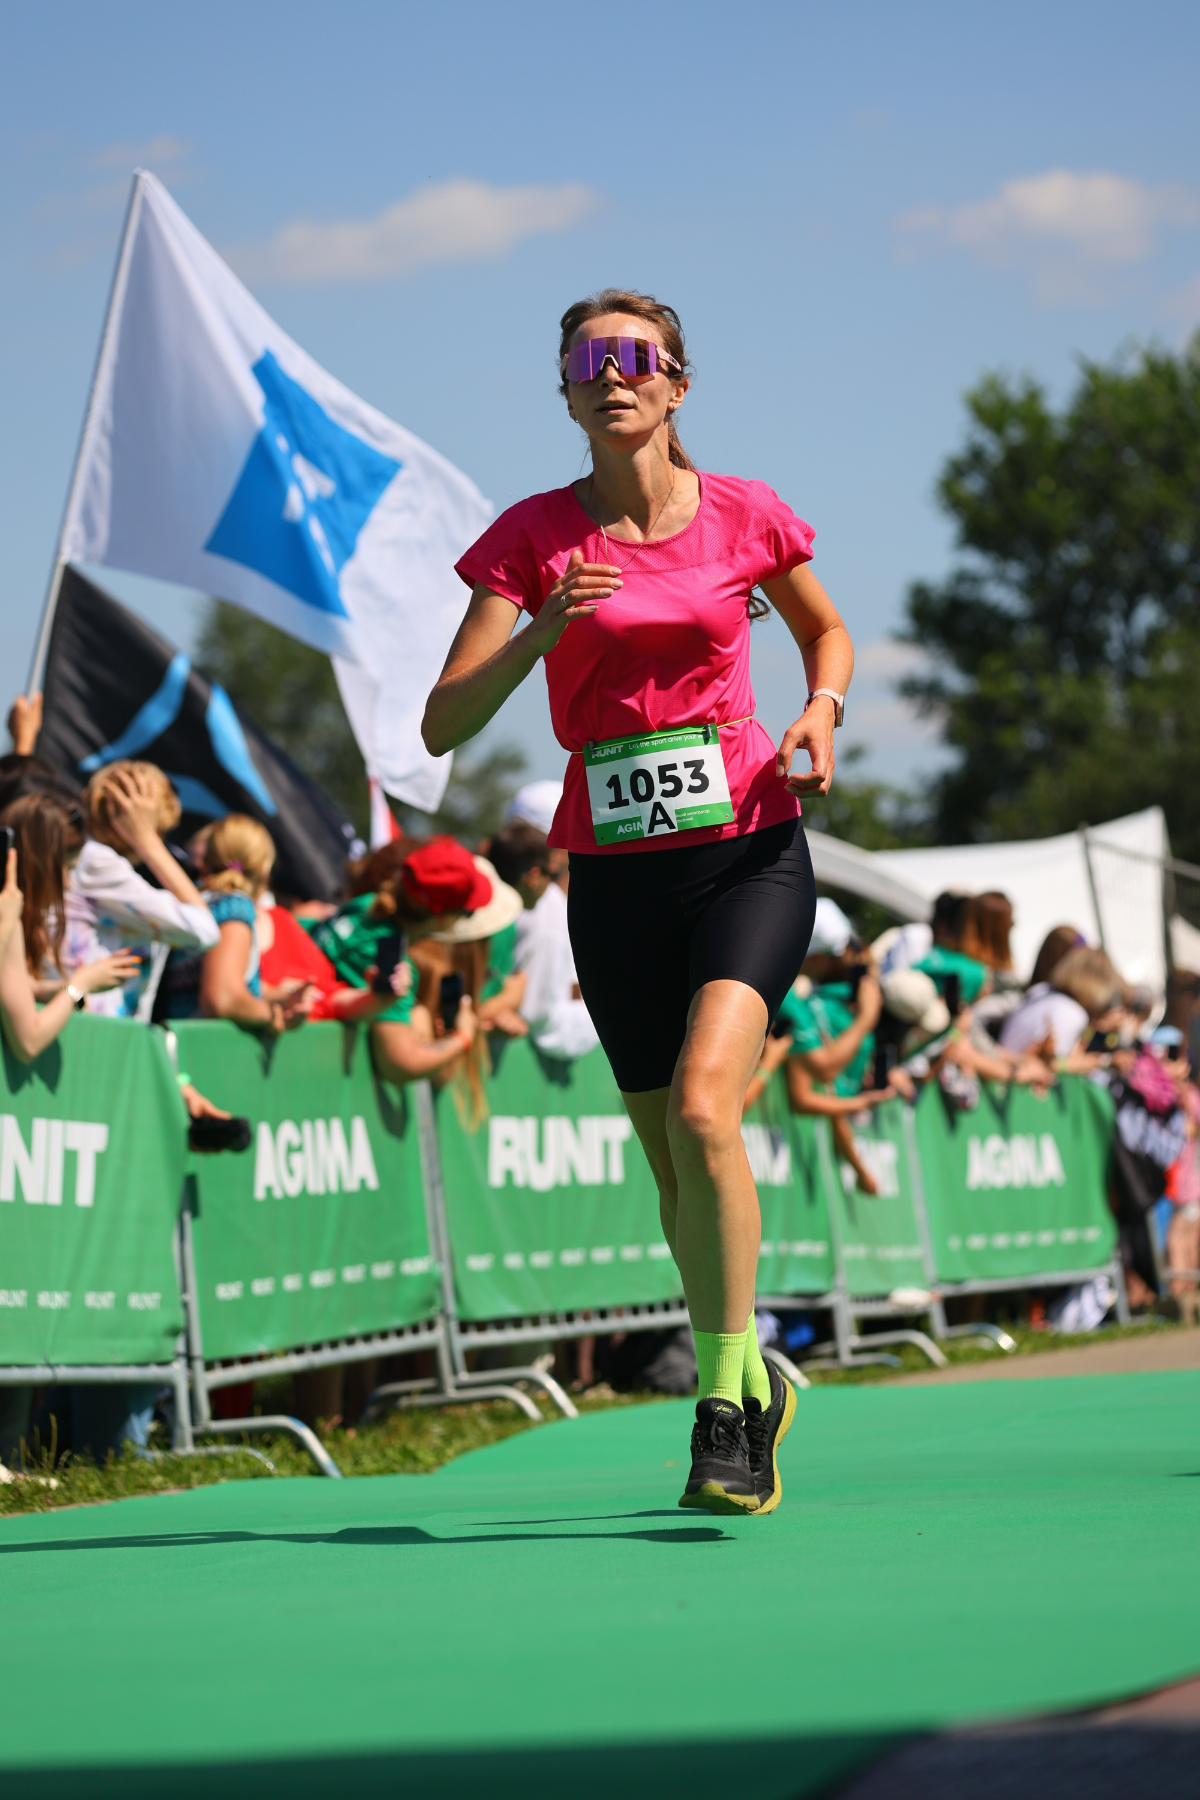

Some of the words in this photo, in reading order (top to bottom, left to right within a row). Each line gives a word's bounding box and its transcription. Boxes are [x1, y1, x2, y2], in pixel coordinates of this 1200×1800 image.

[592, 745, 624, 759] RUNIT
[651, 737, 667, 747] sport
[668, 736, 683, 744] drive
[683, 734, 696, 742] your
[605, 759, 710, 810] 1053
[617, 821, 644, 835] AGIM
[647, 801, 676, 834] A
[0, 1114, 109, 1207] NIT
[254, 1115, 379, 1201] AGIMA
[488, 1115, 631, 1193] RUNIT
